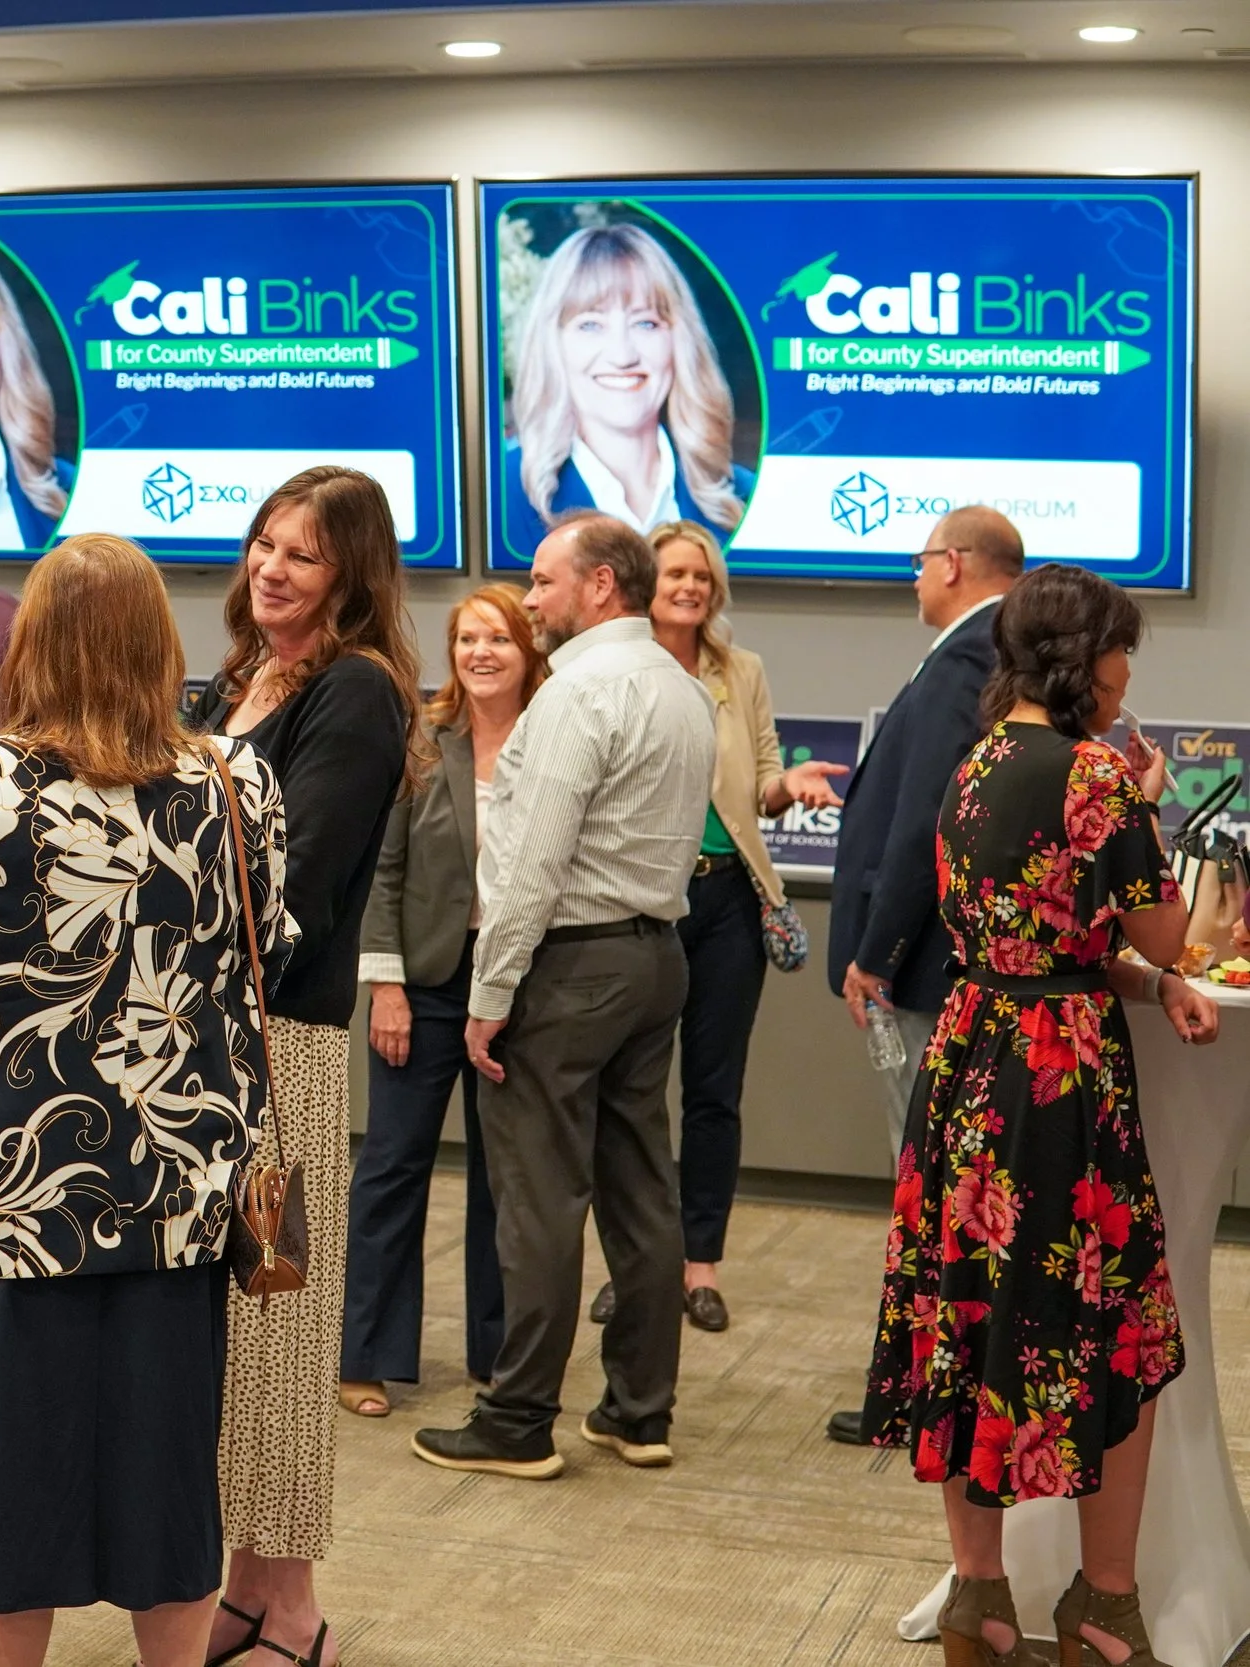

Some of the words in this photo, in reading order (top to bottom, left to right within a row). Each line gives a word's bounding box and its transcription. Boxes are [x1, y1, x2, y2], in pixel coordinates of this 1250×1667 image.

[113, 277, 248, 335] Cali
[259, 275, 418, 334] Binks
[806, 272, 960, 335] Cali
[974, 273, 1151, 336] Binks
[116, 344, 144, 363] for
[146, 344, 217, 367] County
[219, 343, 373, 366] Superintendent
[807, 342, 839, 364] for
[842, 342, 923, 368] County
[926, 343, 1100, 369] Superintendent
[116, 372, 162, 391] Bright
[164, 372, 246, 391] Beginnings
[247, 372, 277, 388] and
[278, 372, 314, 388] Bold
[315, 371, 375, 389] Futures
[806, 373, 859, 394] Bright
[861, 373, 955, 396] Beginnings
[956, 375, 991, 393] and
[991, 375, 1033, 393] Bold
[1033, 376, 1100, 395] Futures
